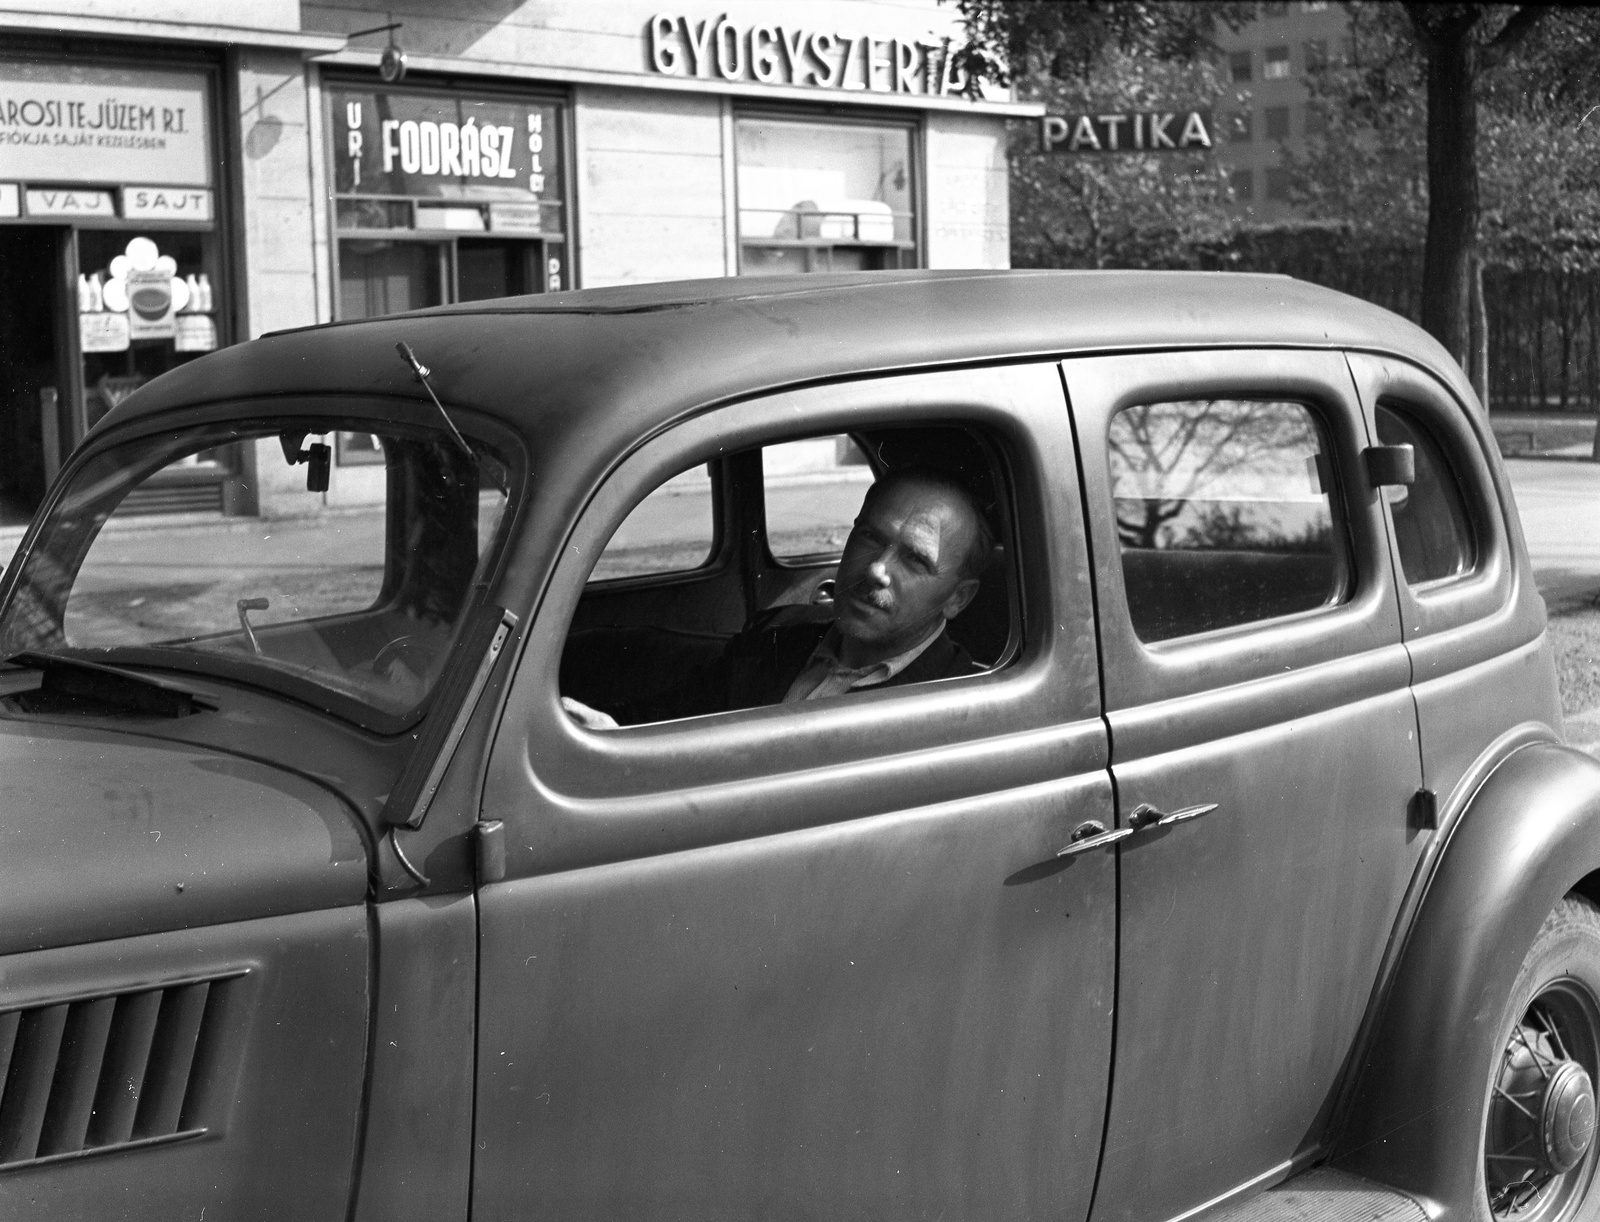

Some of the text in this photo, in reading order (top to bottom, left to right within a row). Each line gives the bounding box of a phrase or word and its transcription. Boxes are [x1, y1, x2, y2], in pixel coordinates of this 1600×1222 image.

[347, 101, 363, 186] URI
[382, 116, 516, 178] FODRÁSZ
[1043, 111, 1212, 150] PATIKA
[41, 190, 101, 211] VAJ
[135, 191, 204, 210] SAJT
